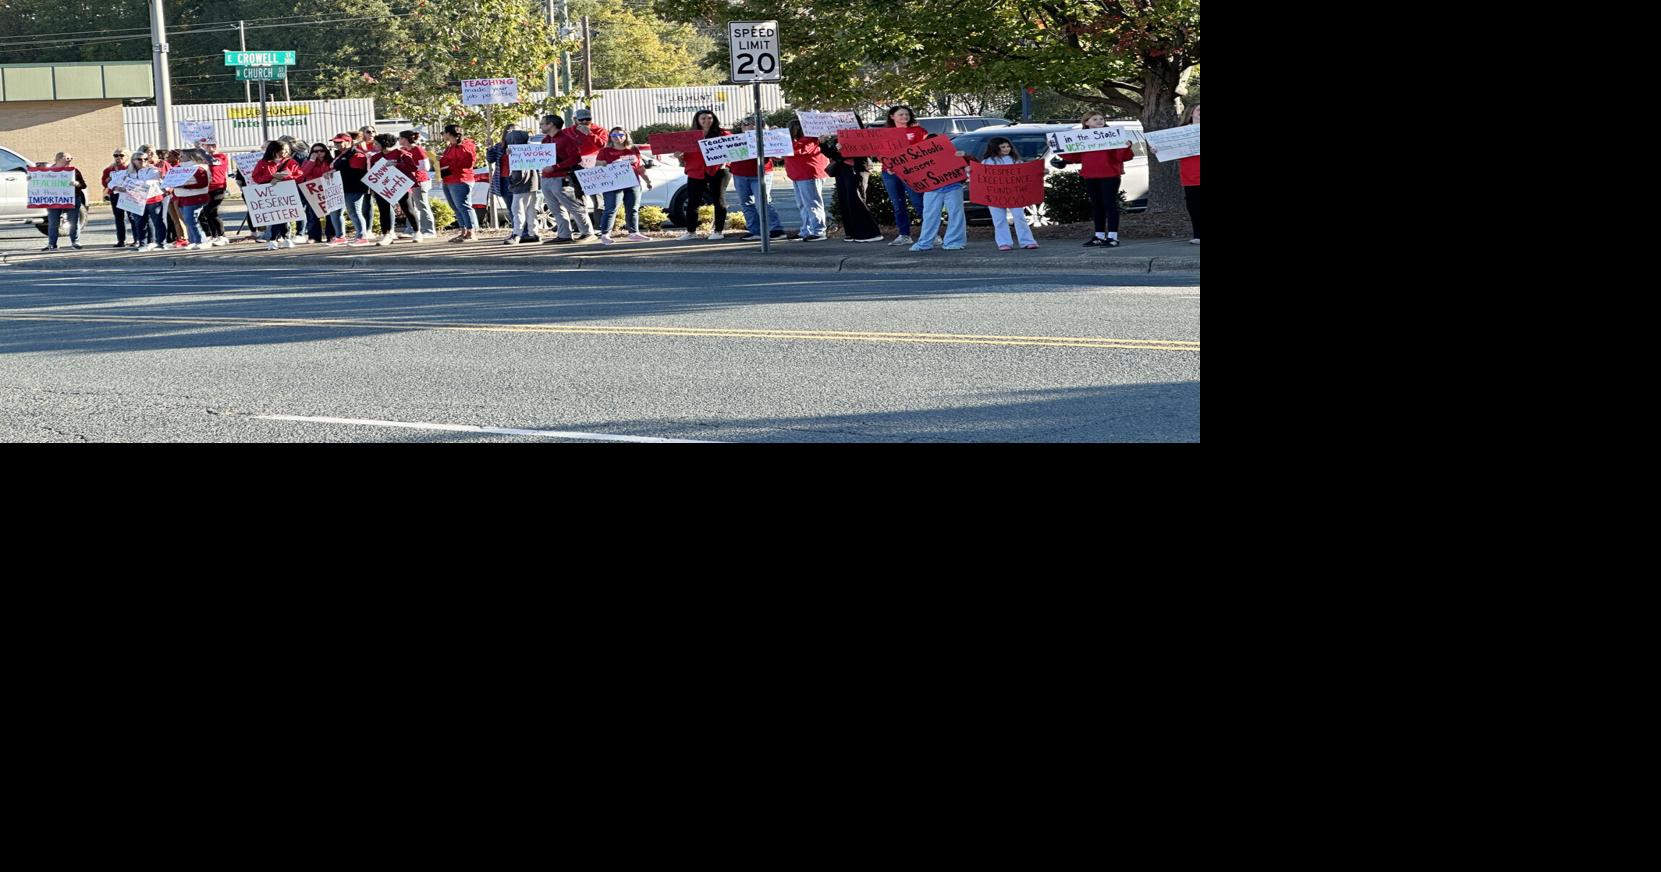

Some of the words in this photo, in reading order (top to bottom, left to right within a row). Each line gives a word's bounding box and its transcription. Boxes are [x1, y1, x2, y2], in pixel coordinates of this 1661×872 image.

[734, 28, 775, 38] SPEED
[739, 41, 770, 50] LIMIT
[227, 54, 233, 62] E
[237, 53, 279, 64] CROWELL
[736, 52, 776, 74] 20
[243, 67, 273, 78] CHURCH
[463, 79, 513, 88] TEACHING
[657, 103, 725, 113] Intermodal
[232, 117, 308, 128] Intemodal
[700, 135, 742, 147] Teachers
[1064, 135, 1073, 143] in
[1093, 128, 1121, 140] State!
[705, 144, 723, 155] just
[906, 141, 944, 160] Schools
[577, 167, 605, 178] Proud
[903, 159, 936, 175] deserve
[367, 164, 389, 184] Show
[255, 185, 276, 198] WE
[380, 174, 408, 200] Worth
[583, 182, 597, 191] not
[28, 196, 74, 204] IMPORTANT
[250, 195, 298, 211] DESERVE
[254, 207, 300, 224] BETTER!
